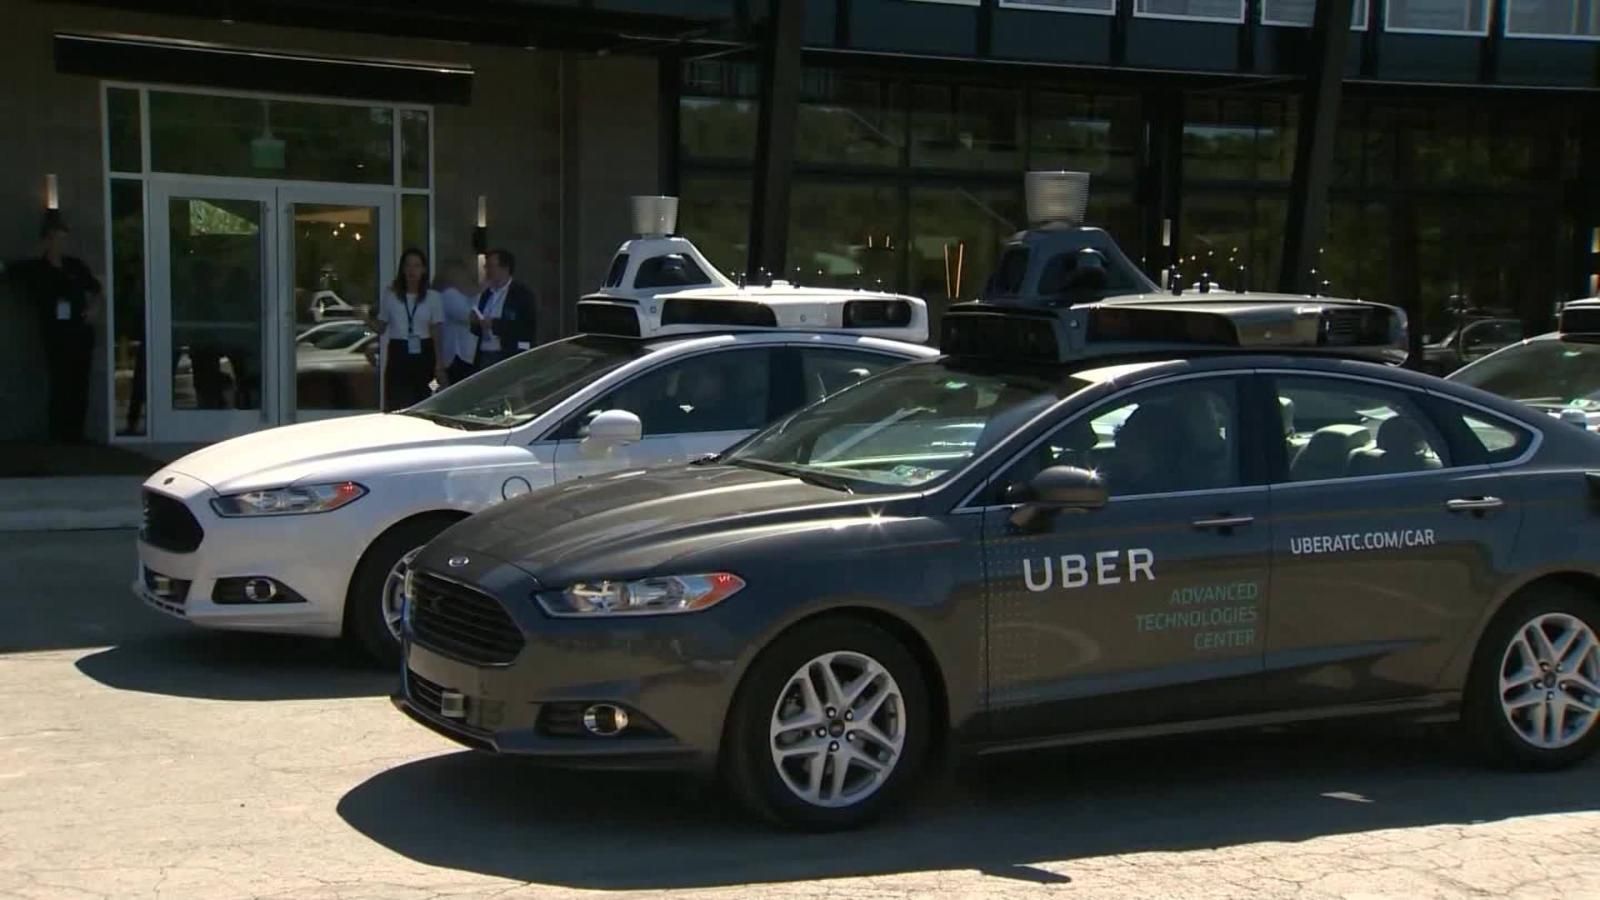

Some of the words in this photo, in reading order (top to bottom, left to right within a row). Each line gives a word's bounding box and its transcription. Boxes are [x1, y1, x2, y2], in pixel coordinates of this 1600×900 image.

[1290, 529, 1435, 555] UBERATC.COM/CAR
[1023, 548, 1155, 592] UBER
[1170, 582, 1258, 605] ADVANCED
[1136, 606, 1258, 632] TECHNOLOGIES
[1194, 629, 1256, 651] CENTER
